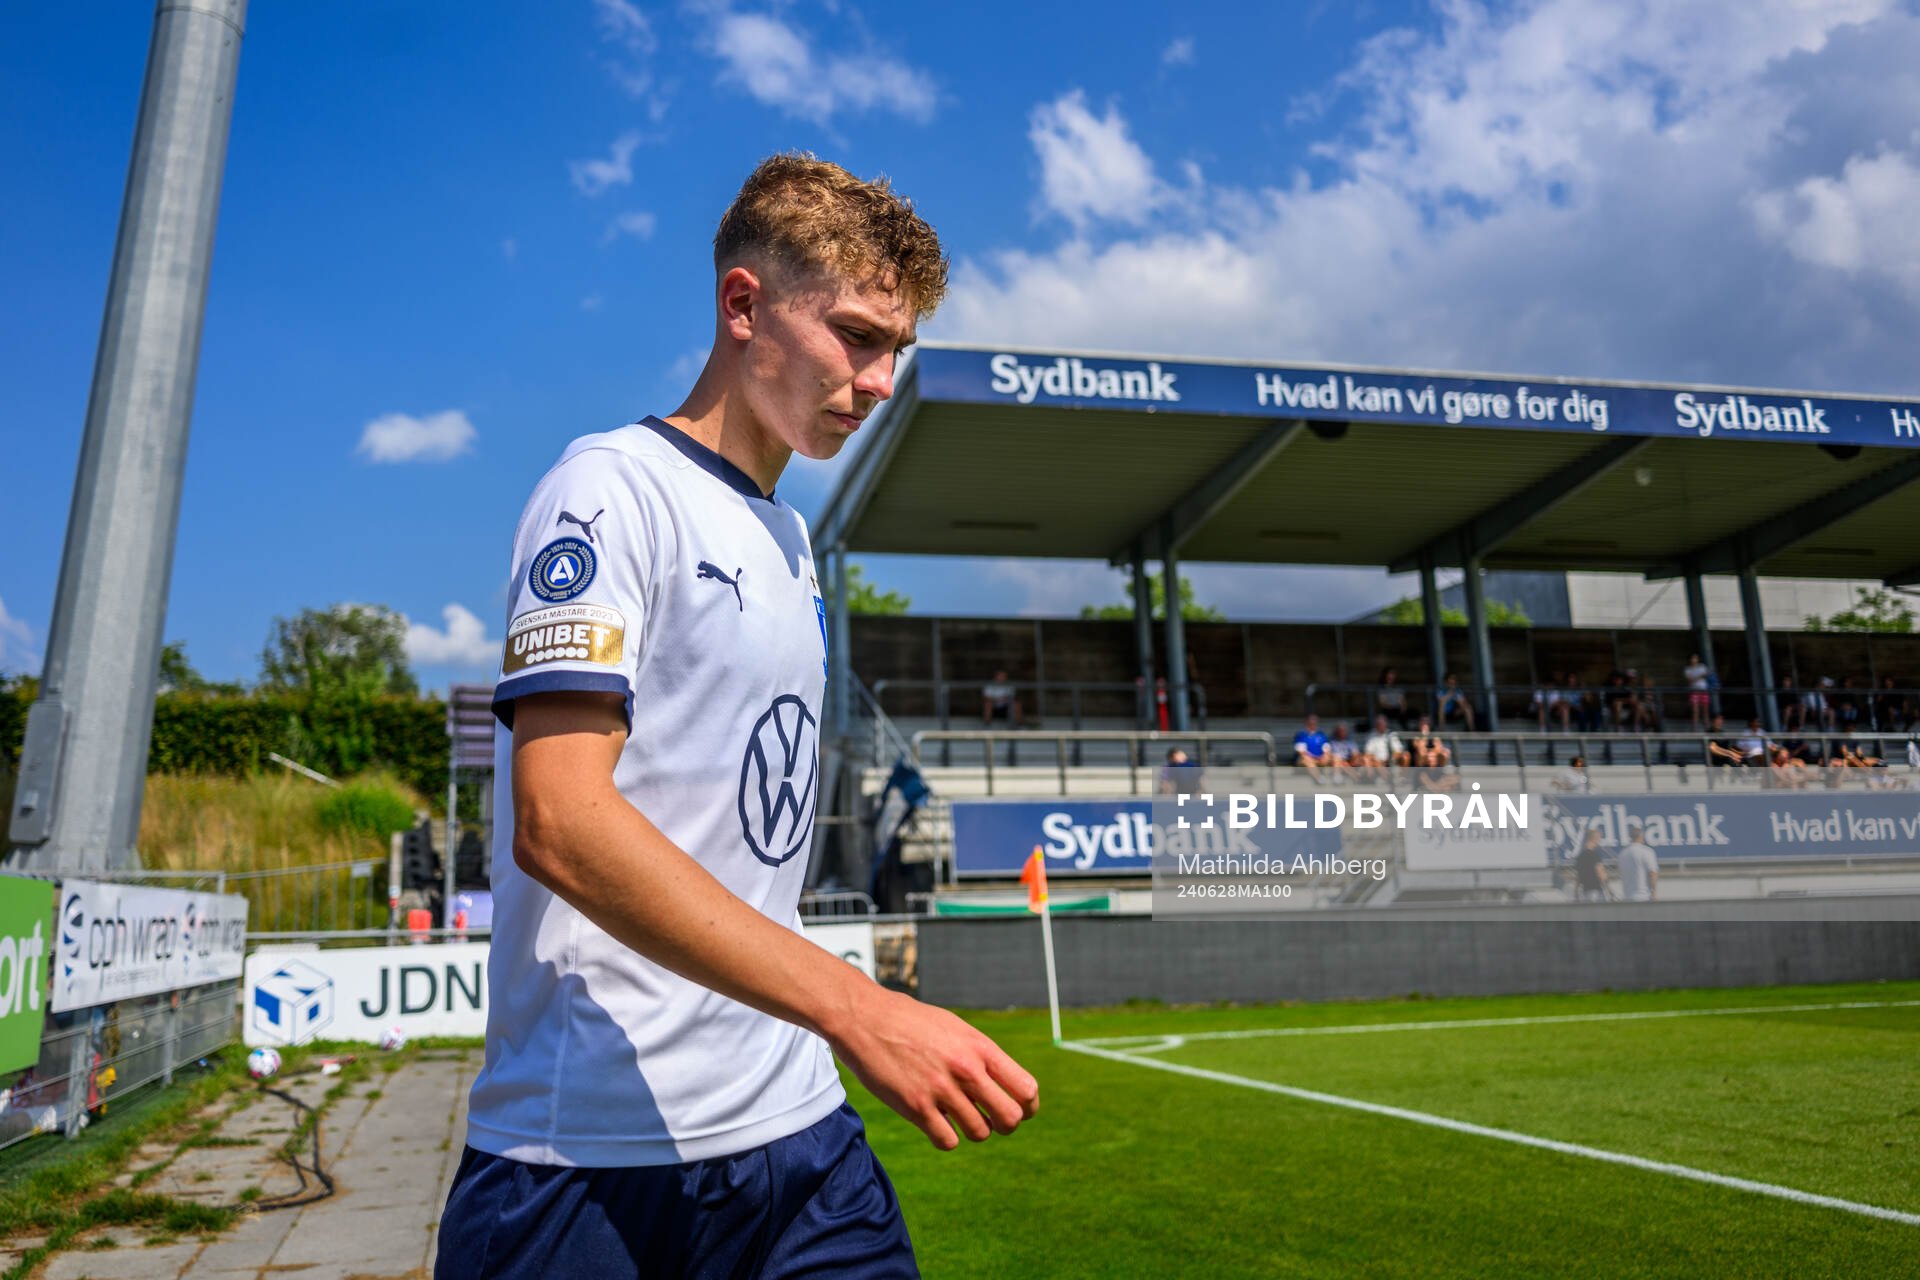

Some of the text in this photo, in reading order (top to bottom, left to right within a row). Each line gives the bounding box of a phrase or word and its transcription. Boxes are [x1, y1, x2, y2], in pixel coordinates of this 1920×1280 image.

[990, 354, 1180, 403] Sydbank
[1255, 372, 1609, 431] Hvad kan vi gøre for dig
[1674, 393, 1830, 436] Sydbank
[514, 624, 611, 655] UNIBET
[515, 612, 548, 629] SVENSKA
[1042, 812, 1261, 870] Sydbank
[1769, 809, 1842, 842] Hvad
[1845, 809, 1896, 841] kan
[360, 963, 481, 1018] JDN
